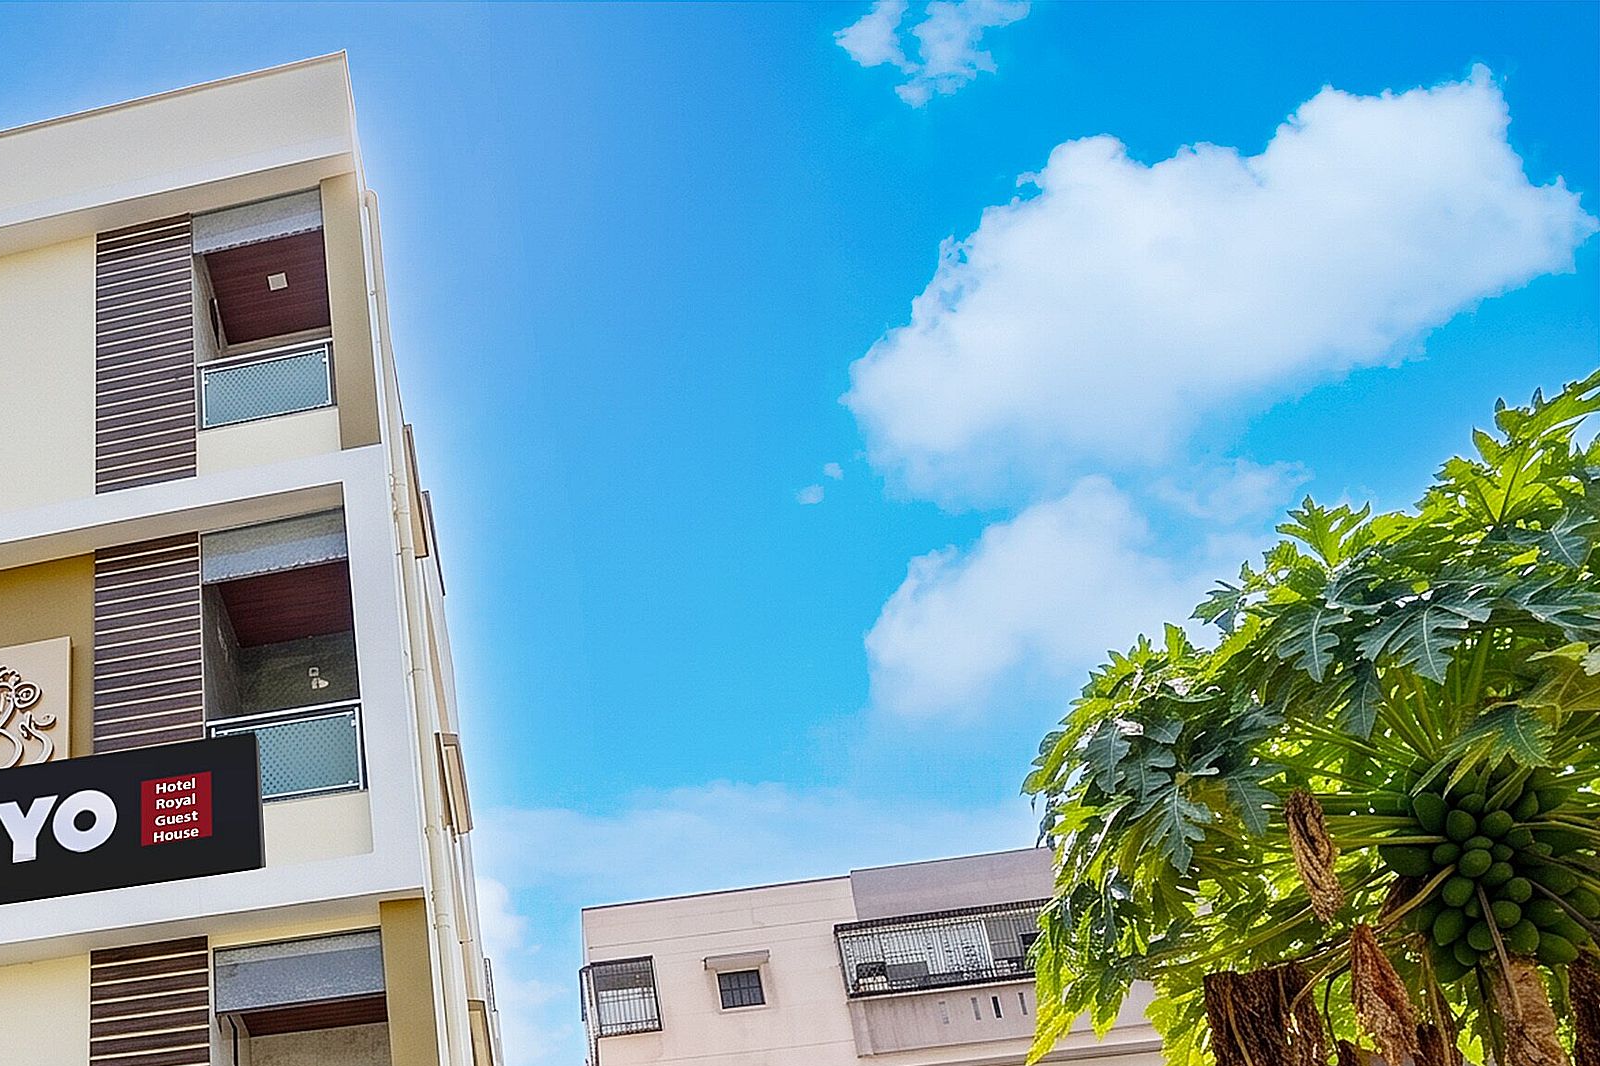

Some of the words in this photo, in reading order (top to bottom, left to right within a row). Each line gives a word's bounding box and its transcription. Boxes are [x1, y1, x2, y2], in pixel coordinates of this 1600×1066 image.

[155, 778, 196, 794] Hotel
[155, 794, 197, 811] Royal
[154, 810, 198, 827] Guest
[152, 826, 199, 843] House
